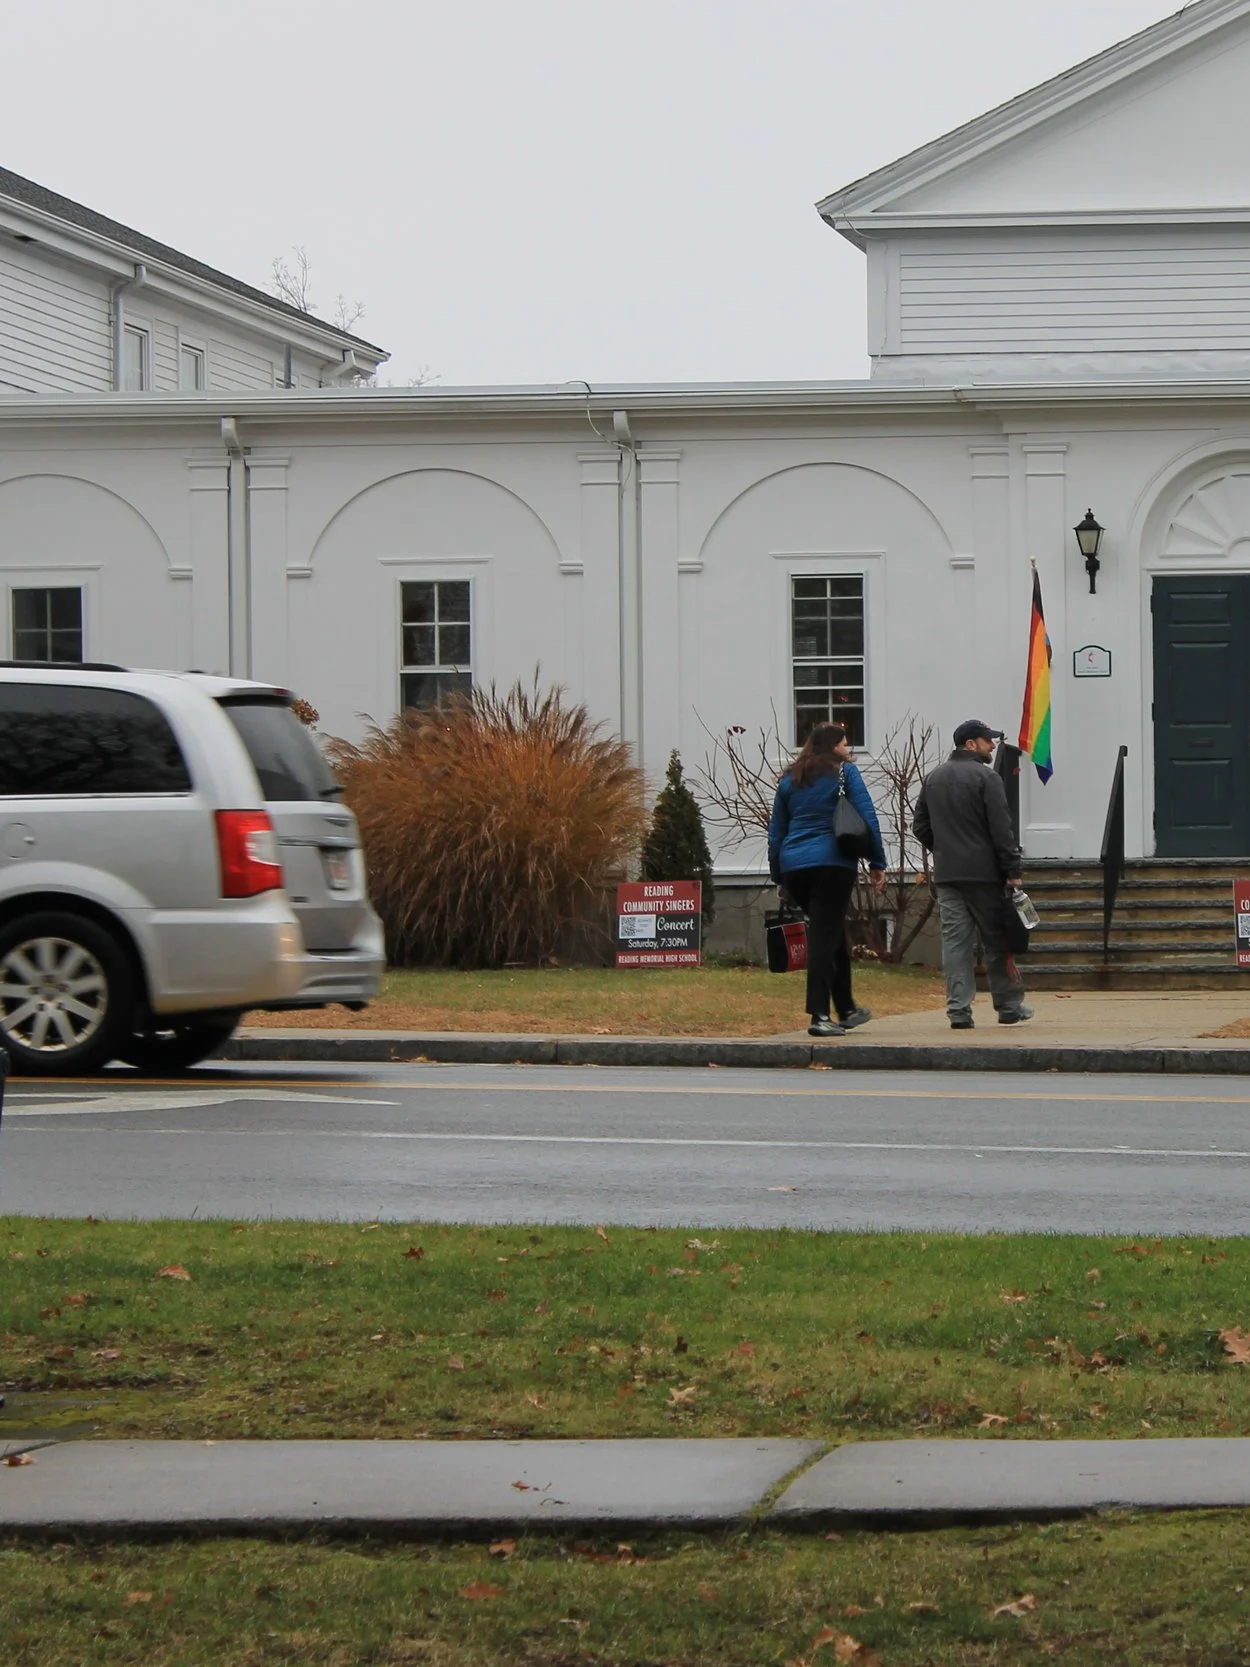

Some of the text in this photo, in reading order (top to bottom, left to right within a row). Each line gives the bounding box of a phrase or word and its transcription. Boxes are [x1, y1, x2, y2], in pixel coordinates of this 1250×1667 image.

[644, 885, 673, 897] READING
[623, 900, 694, 912] COMMUNITY SINGERS
[657, 917, 694, 931] Concert
[628, 938, 688, 950] Saturday, 7:30PM
[618, 954, 697, 963] READING MEMORIAL HIGH SCHOOL
